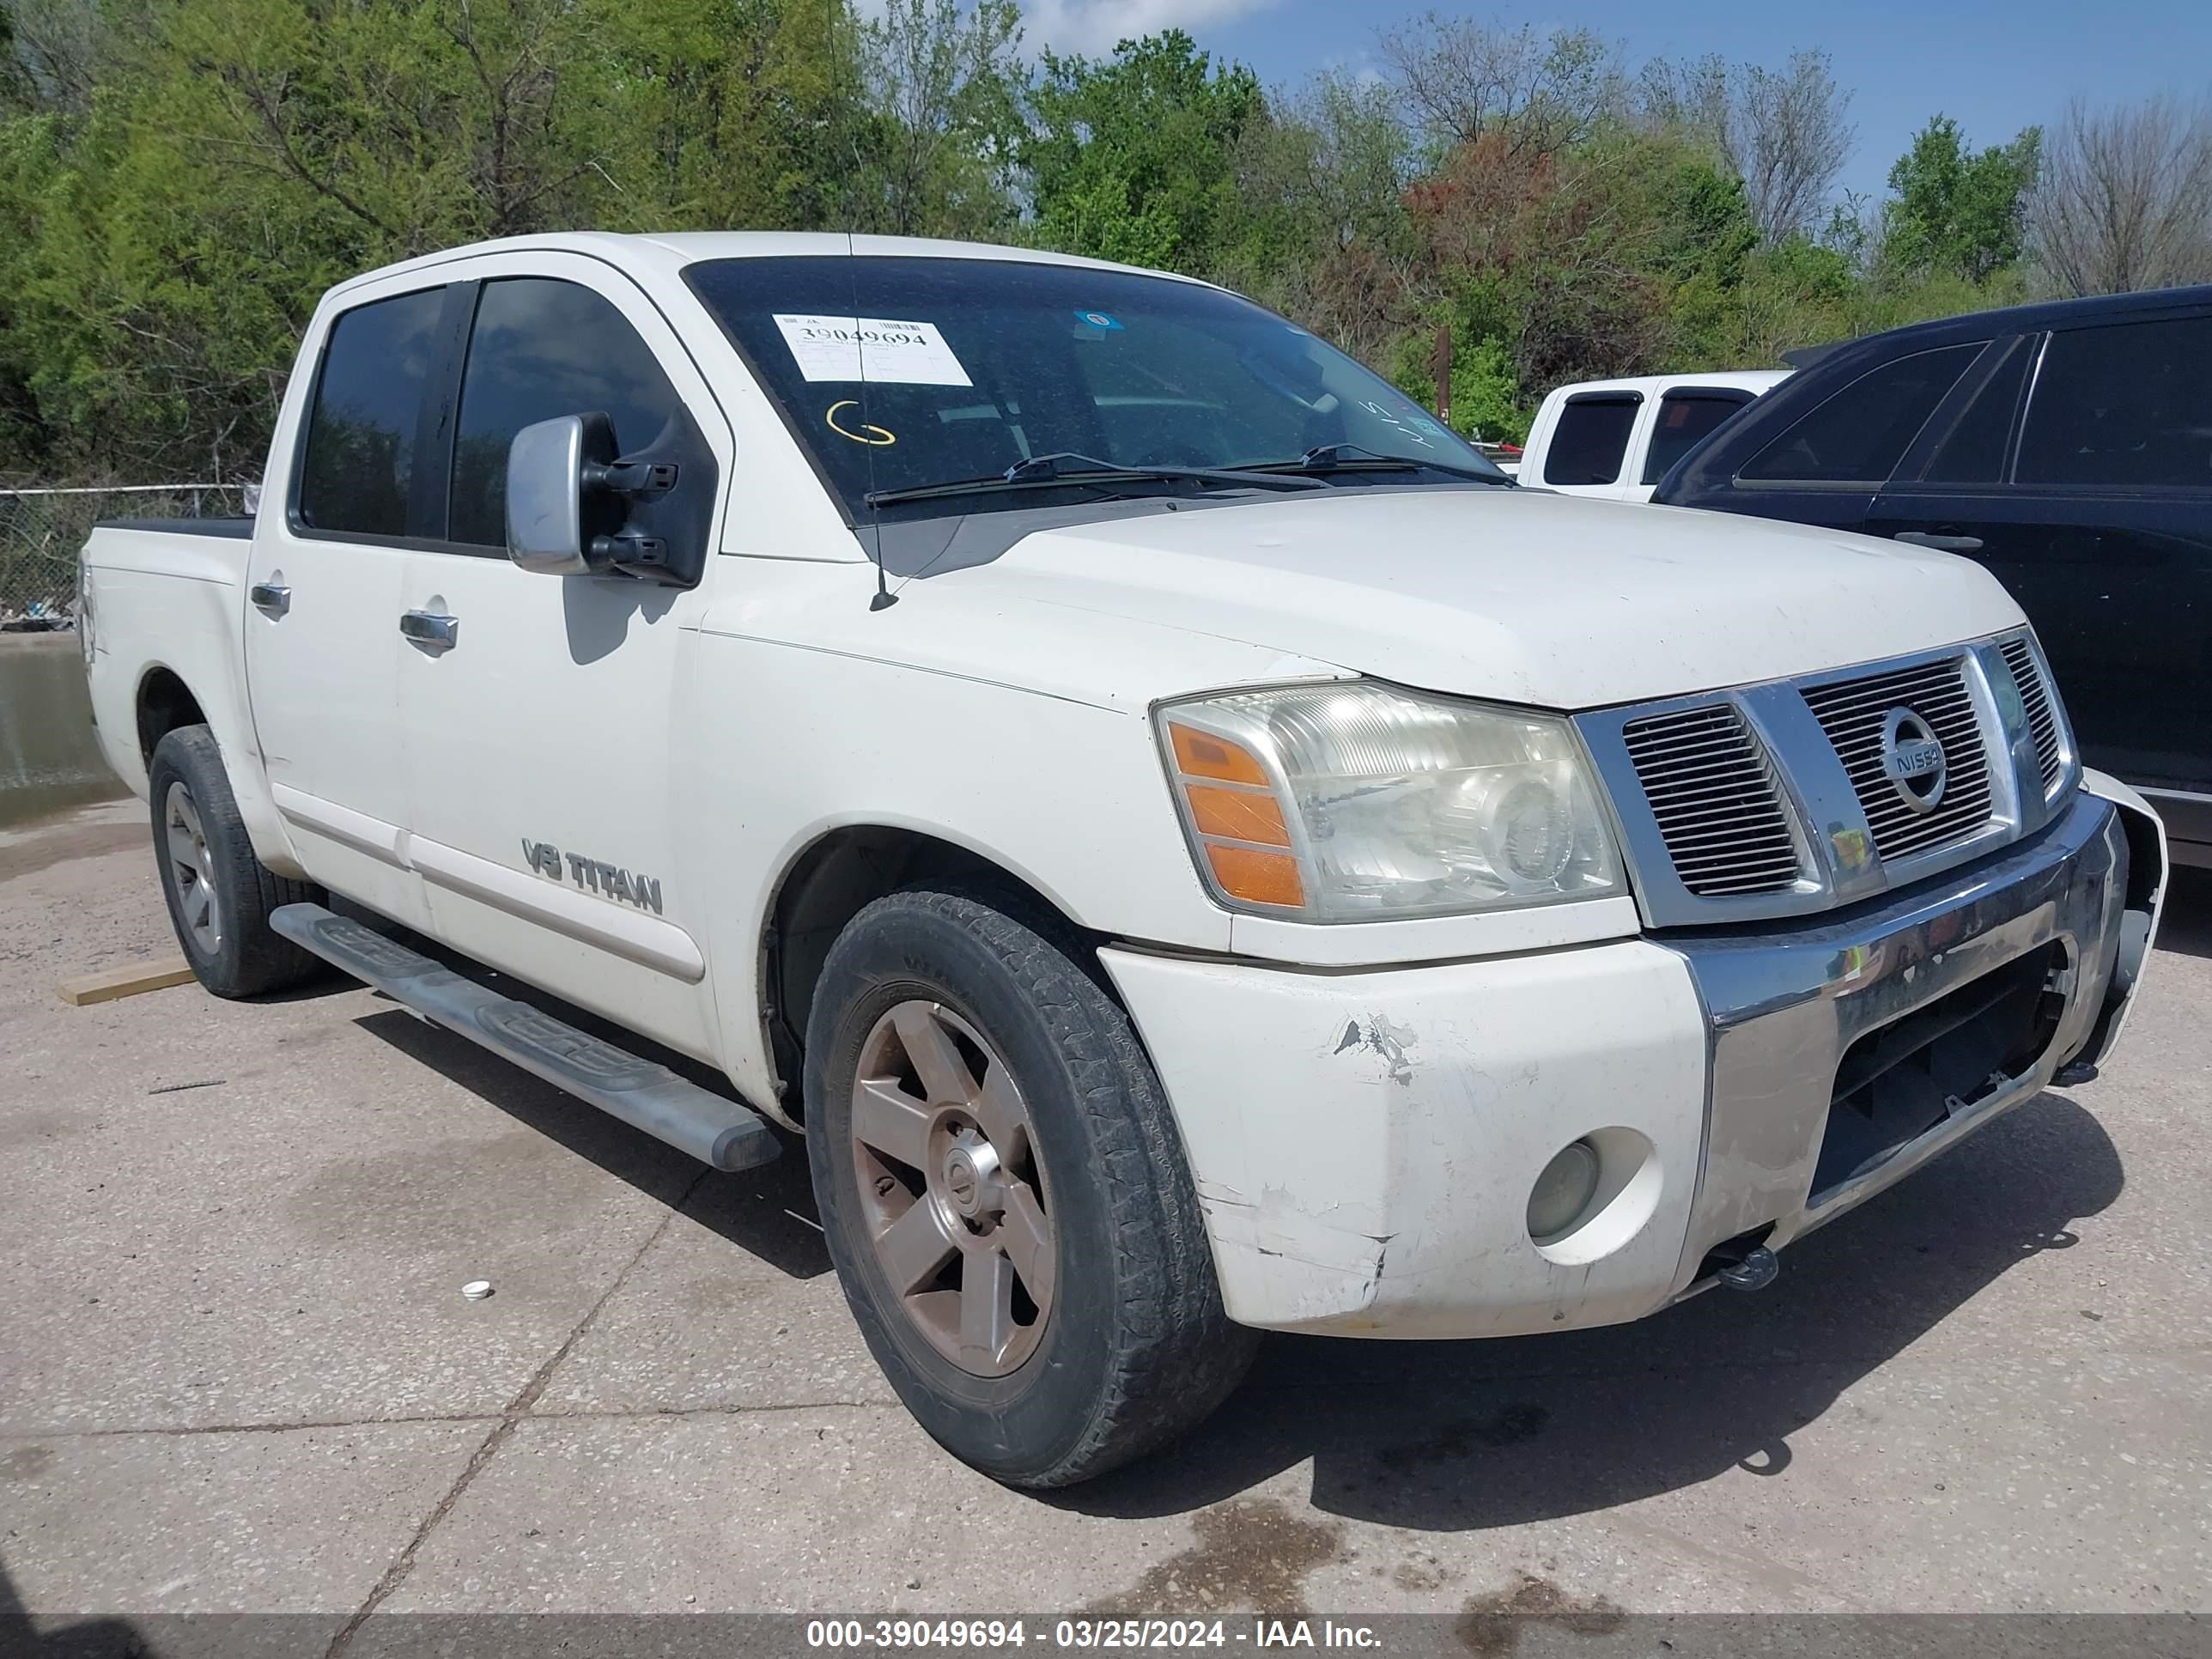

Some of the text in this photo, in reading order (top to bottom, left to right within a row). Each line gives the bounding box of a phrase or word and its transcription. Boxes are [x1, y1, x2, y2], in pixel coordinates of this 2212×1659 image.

[799, 327, 927, 347] 39049694
[1896, 748, 1942, 773] NISSA
[521, 837, 664, 915] V8 TITAN
